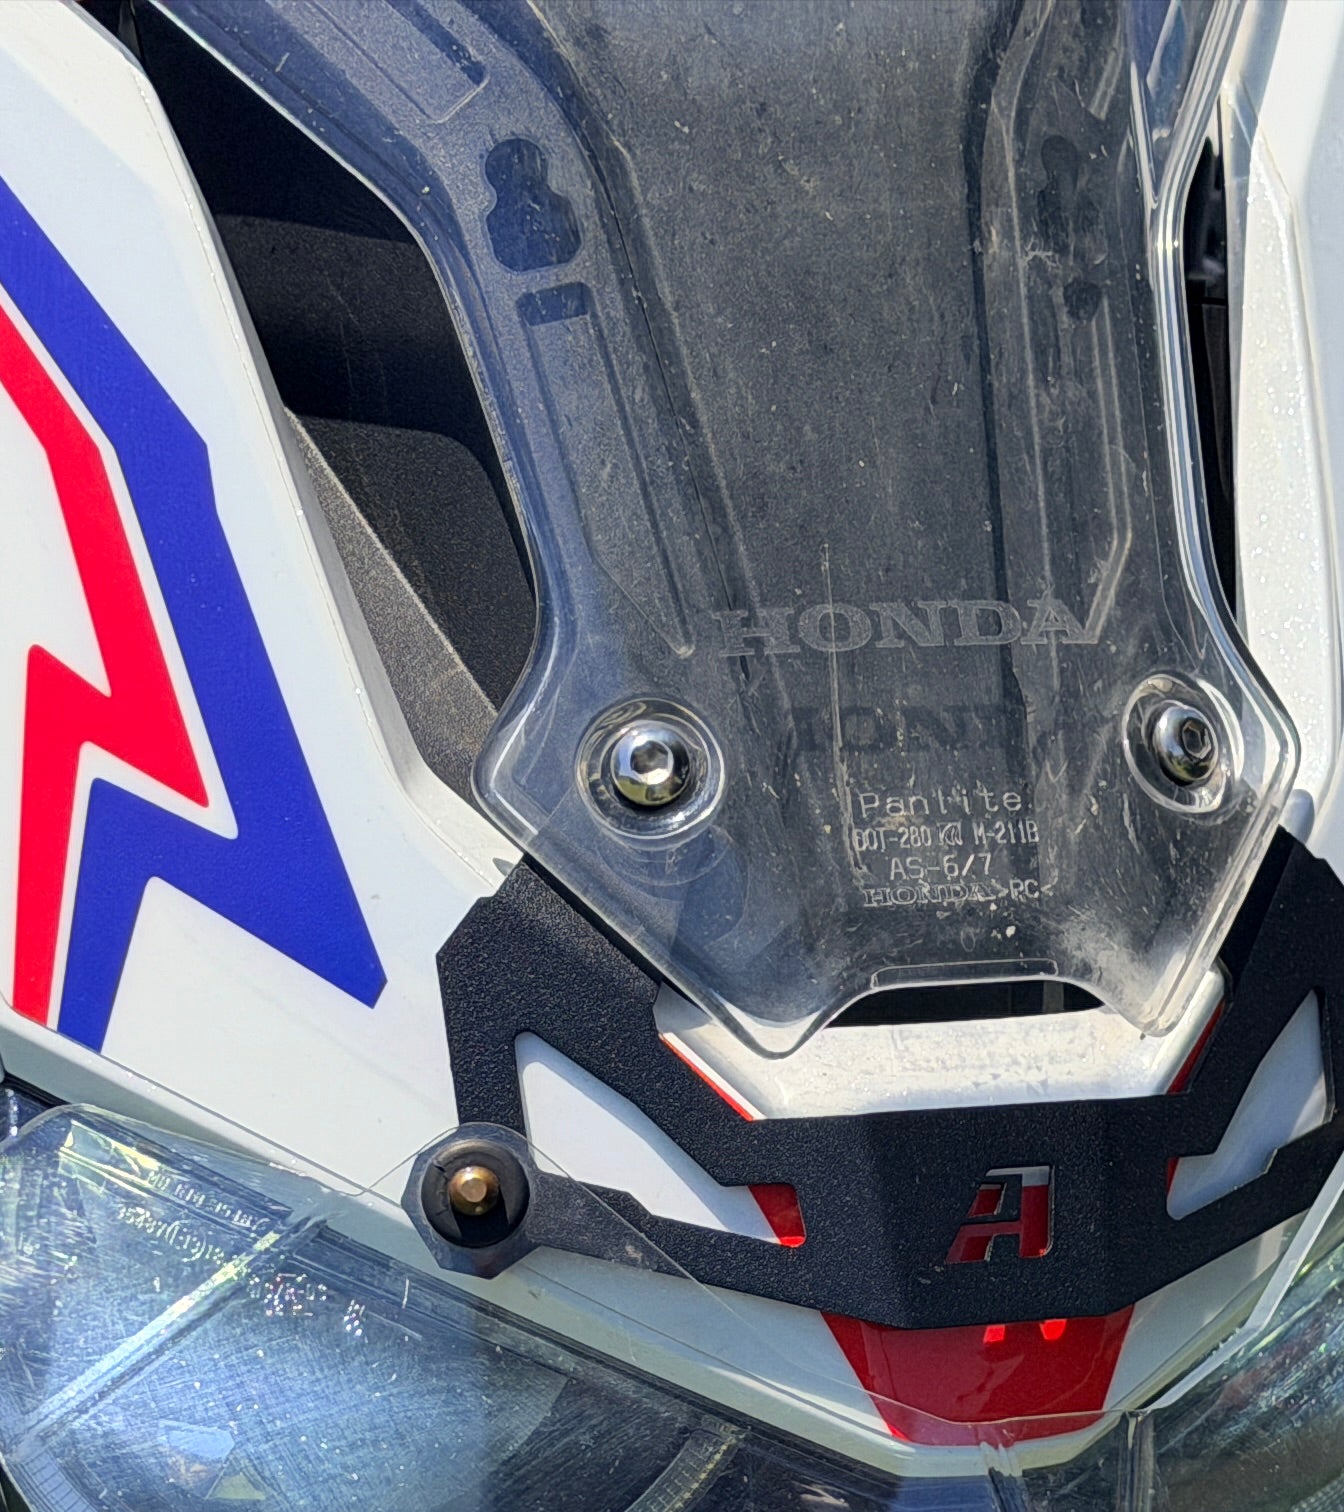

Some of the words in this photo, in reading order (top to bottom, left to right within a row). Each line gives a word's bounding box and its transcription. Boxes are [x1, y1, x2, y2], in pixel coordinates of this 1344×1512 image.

[712, 599, 1099, 656] HONDA
[889, 852, 992, 881] AS-6/7
[863, 880, 997, 907] HONDA
